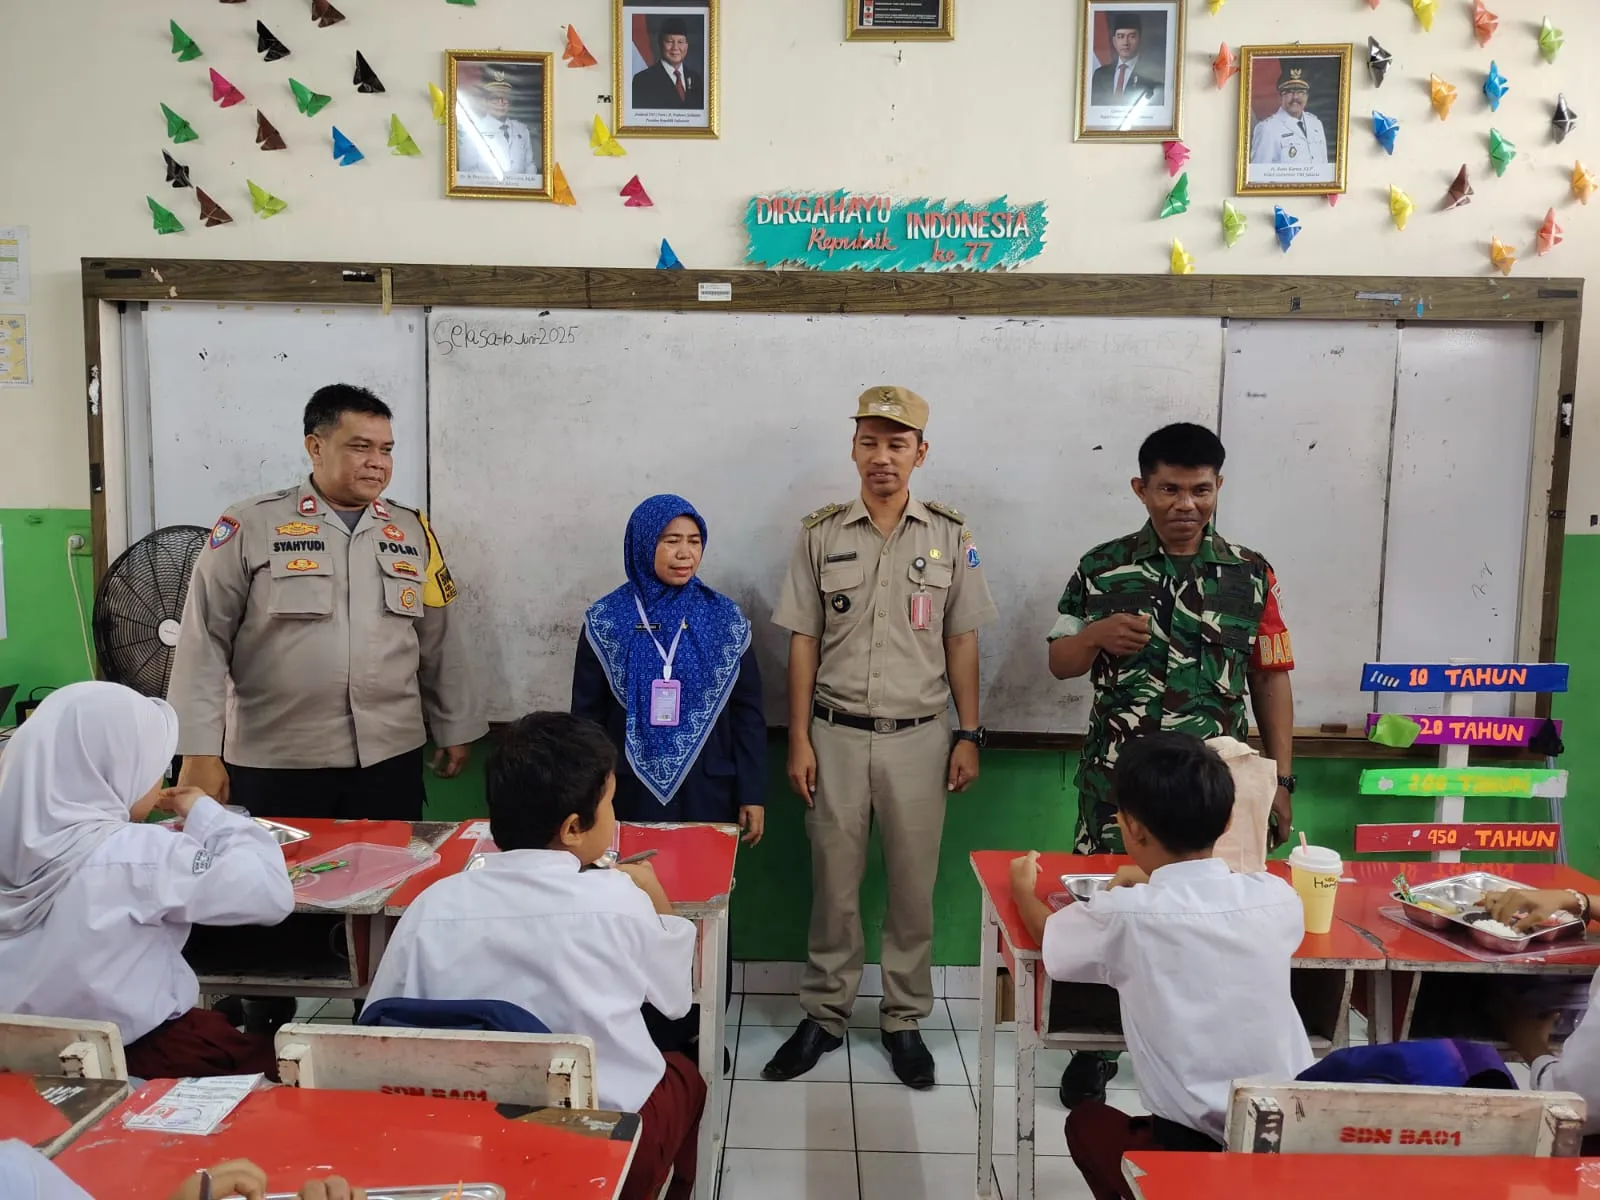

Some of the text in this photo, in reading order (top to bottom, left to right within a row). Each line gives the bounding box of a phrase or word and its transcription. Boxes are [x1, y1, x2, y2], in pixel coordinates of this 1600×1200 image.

[756, 196, 892, 225] DIRGAHAYU
[906, 211, 1030, 240] INDONESIA
[964, 241, 993, 263] 77
[273, 540, 325, 553] SYAHYUDI
[379, 542, 419, 557] POLRI
[1408, 667, 1527, 687] 10 TAHUN
[1420, 718, 1525, 741] 20 TAHUN
[1427, 829, 1556, 848] 450 TAHUN
[1340, 1126, 1393, 1144] SDN
